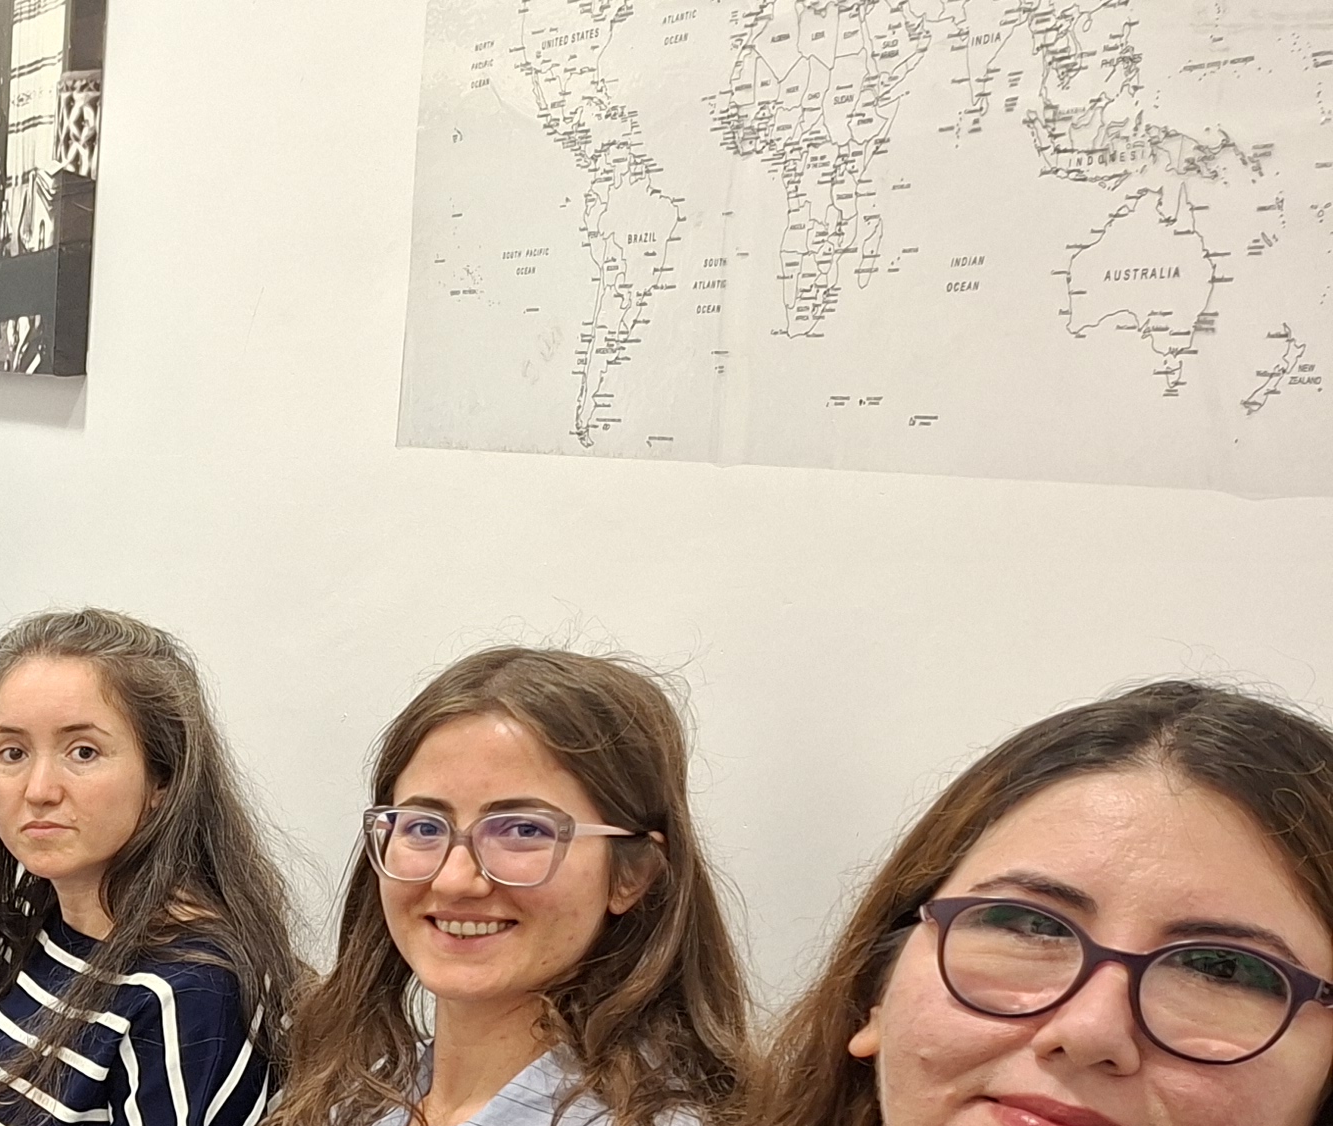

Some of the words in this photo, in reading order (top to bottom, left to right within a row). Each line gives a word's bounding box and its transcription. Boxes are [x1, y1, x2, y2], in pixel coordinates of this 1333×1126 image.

[662, 9, 698, 25] ATLANTIC
[541, 34, 569, 50] UNITED
[571, 27, 600, 44] STATES
[664, 32, 689, 46] OCEAN
[971, 32, 1002, 46] INDIA
[474, 40, 495, 52] NORTH
[470, 78, 490, 89] OCEAN
[1069, 150, 1158, 167] INDONESIA
[627, 233, 657, 244] BRAZIL
[703, 258, 727, 268] SOUTH
[950, 255, 985, 268] INDIAN
[516, 267, 536, 276] OCEAN
[1104, 266, 1181, 282] AUSTRALIA
[692, 280, 727, 290] ATLANTIC
[946, 281, 980, 293] OCEAN
[696, 304, 721, 314] OCEAN
[1298, 364, 1316, 373] NEW
